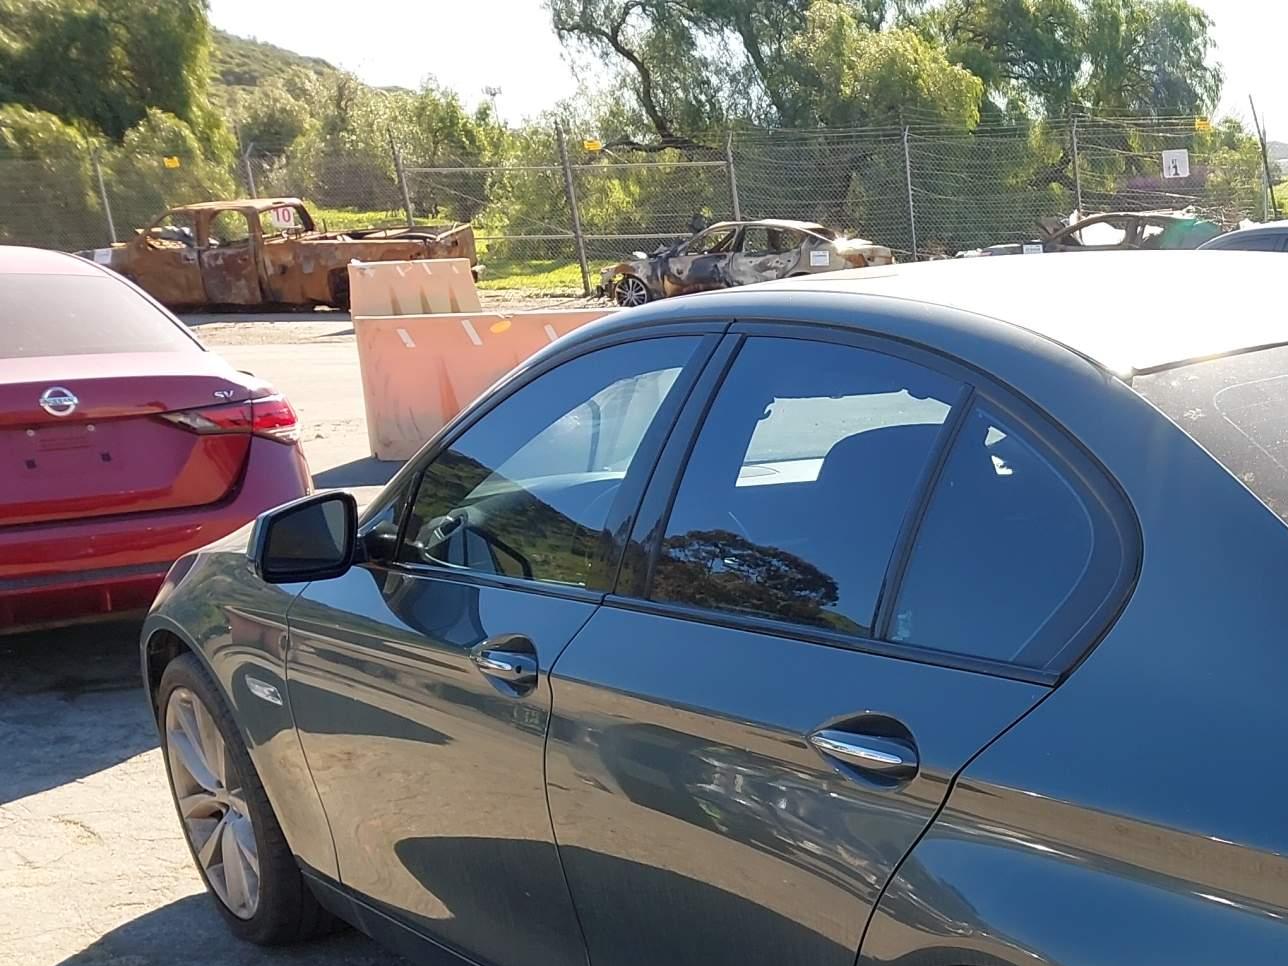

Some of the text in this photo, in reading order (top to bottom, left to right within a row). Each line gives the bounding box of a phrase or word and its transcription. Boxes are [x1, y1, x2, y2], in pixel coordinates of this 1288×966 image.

[1172, 164, 1180, 176] 1
[273, 207, 291, 223] 10
[213, 390, 235, 398] SV
